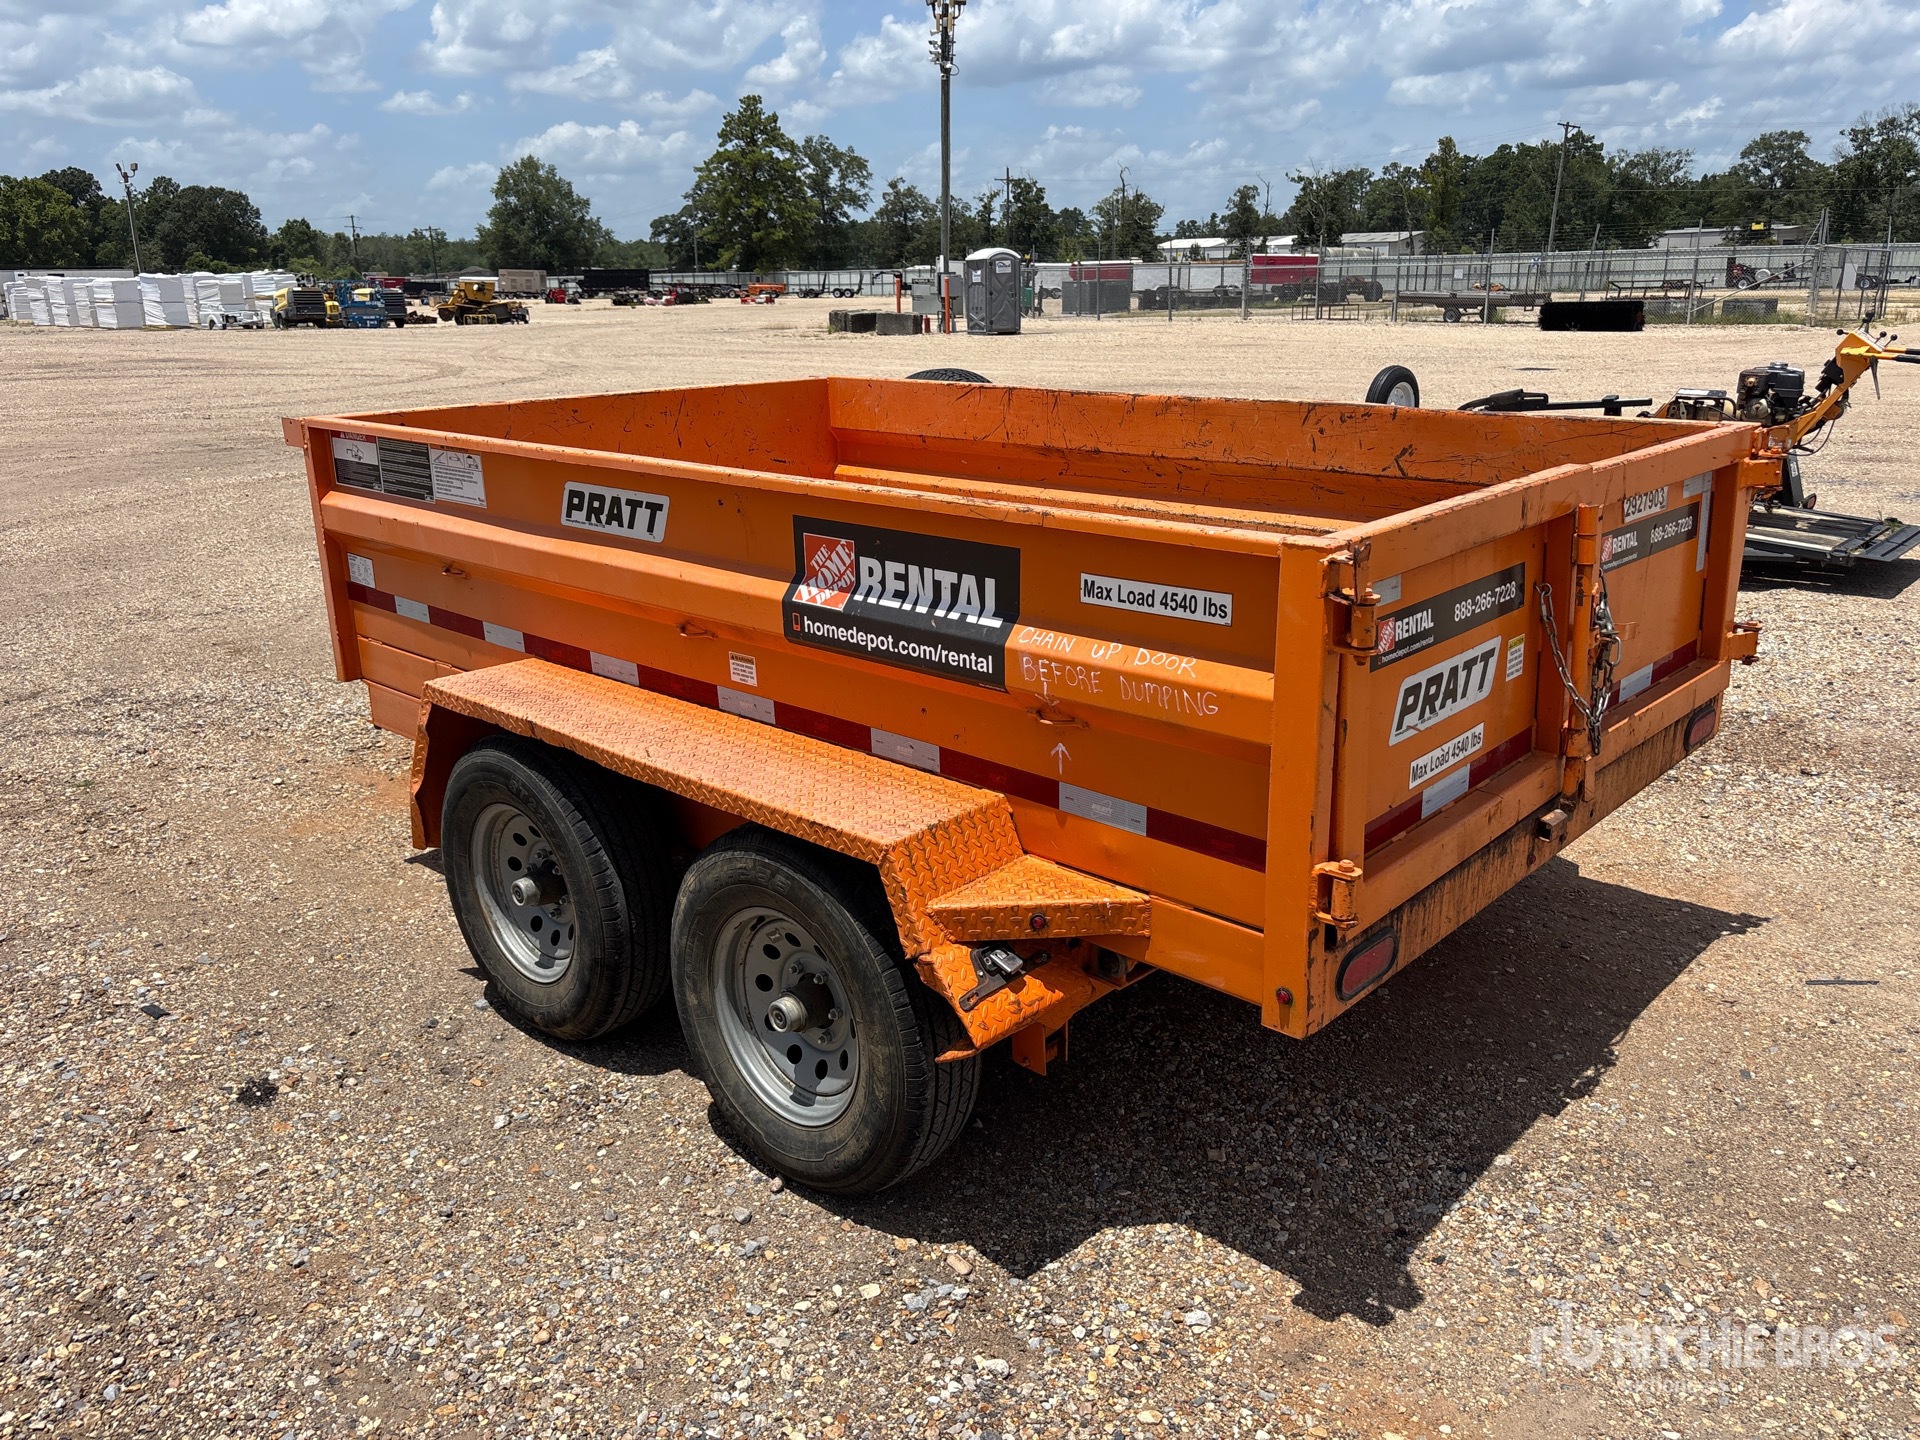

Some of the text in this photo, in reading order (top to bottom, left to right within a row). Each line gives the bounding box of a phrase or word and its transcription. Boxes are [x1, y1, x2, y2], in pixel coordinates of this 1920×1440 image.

[565, 488, 664, 534] PRATT
[1625, 486, 1665, 518] 2927903
[1612, 530, 1638, 555] RENTAL
[1650, 515, 1693, 544] 888-266-7228
[799, 539, 855, 602] HOME
[809, 543, 831, 571] THE
[814, 567, 855, 605] DEPOT
[853, 555, 1004, 629] RENTAL
[1083, 578, 1228, 620] Max Load 4540 lbs
[1453, 580, 1517, 623] 888-266-7228
[804, 615, 993, 674] homedepot.com/rental
[1395, 608, 1435, 642] RENTAL
[1018, 626, 1077, 653] CHAIN
[1133, 647, 1197, 678] DOOR
[1381, 634, 1435, 663] homedepot.com/rental
[1022, 656, 1219, 717] BEFORE DUMPING
[1395, 646, 1497, 733] PRATT
[1411, 731, 1482, 784] Max Load 4540 lbs
